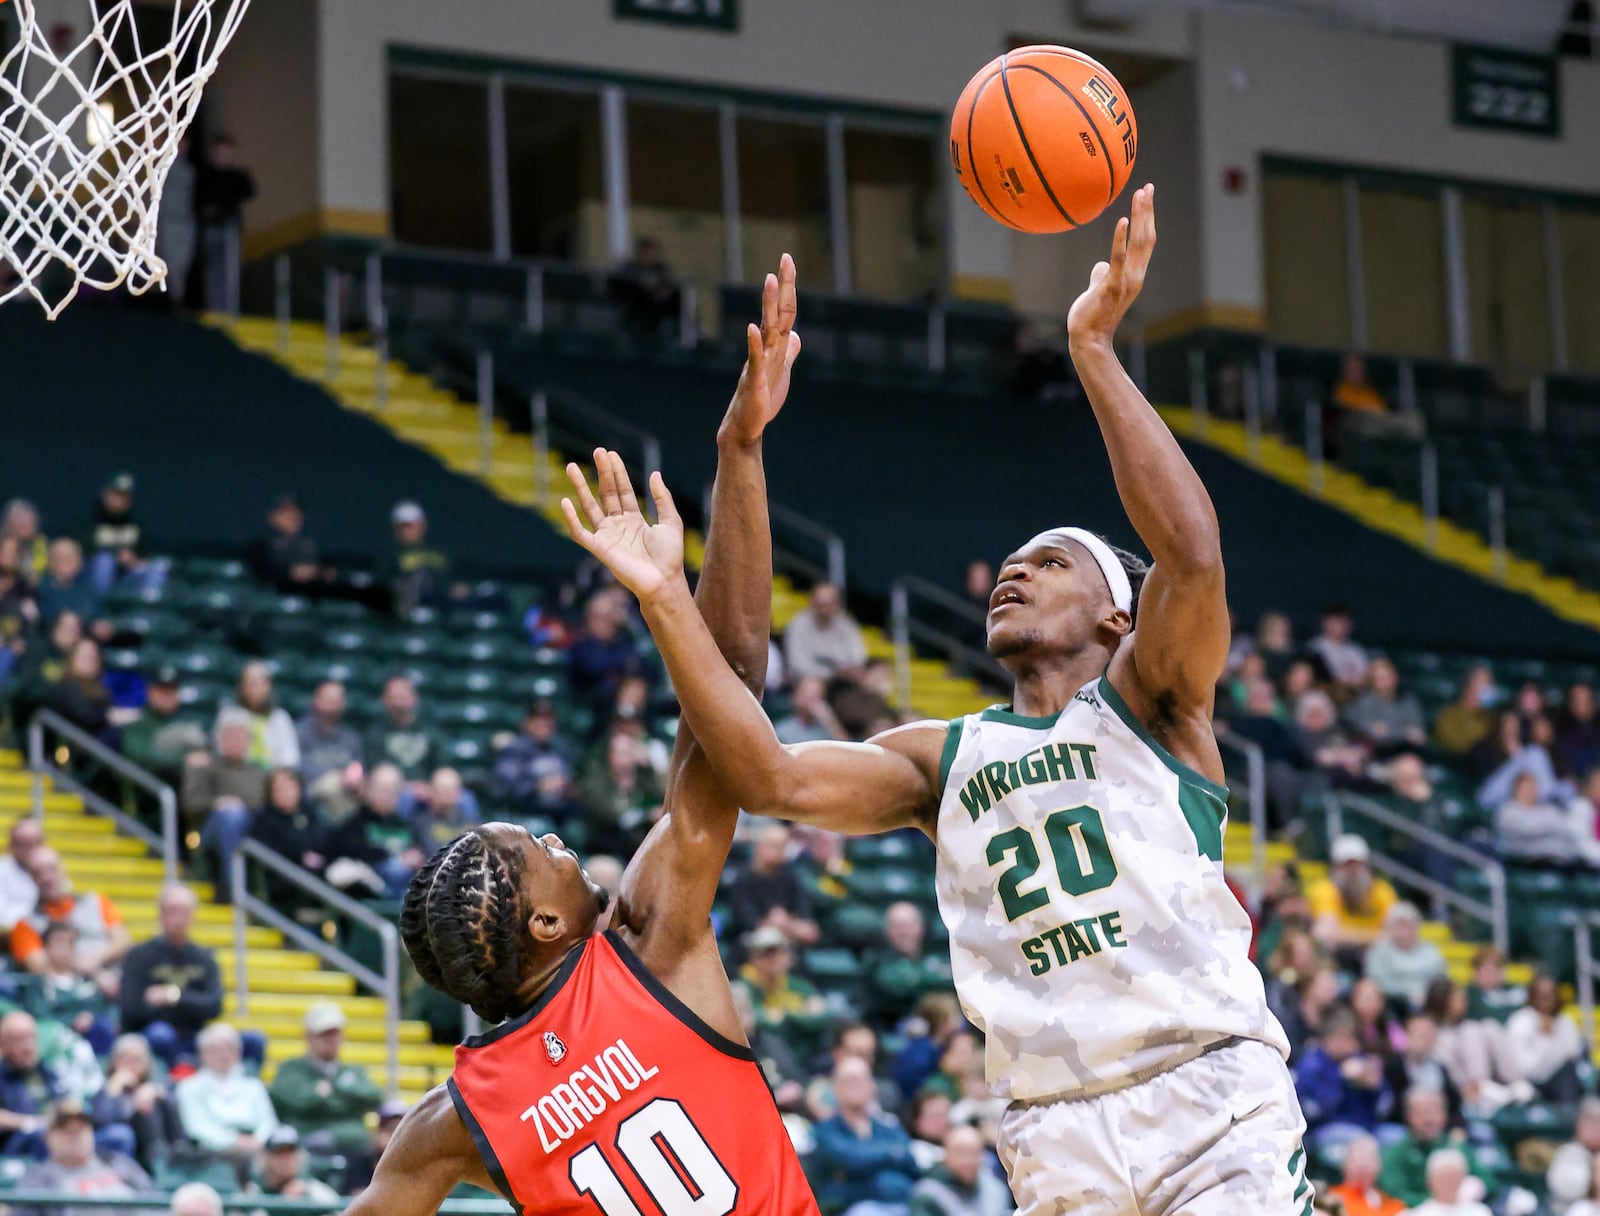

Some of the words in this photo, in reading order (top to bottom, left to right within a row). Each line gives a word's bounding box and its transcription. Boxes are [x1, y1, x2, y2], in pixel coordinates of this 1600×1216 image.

[1087, 74, 1135, 166] ELITE
[958, 742, 1097, 824] WRIGHT
[984, 804, 1119, 923] 20
[1020, 910, 1128, 977] STATE
[519, 1038, 660, 1154] ZORGVOL
